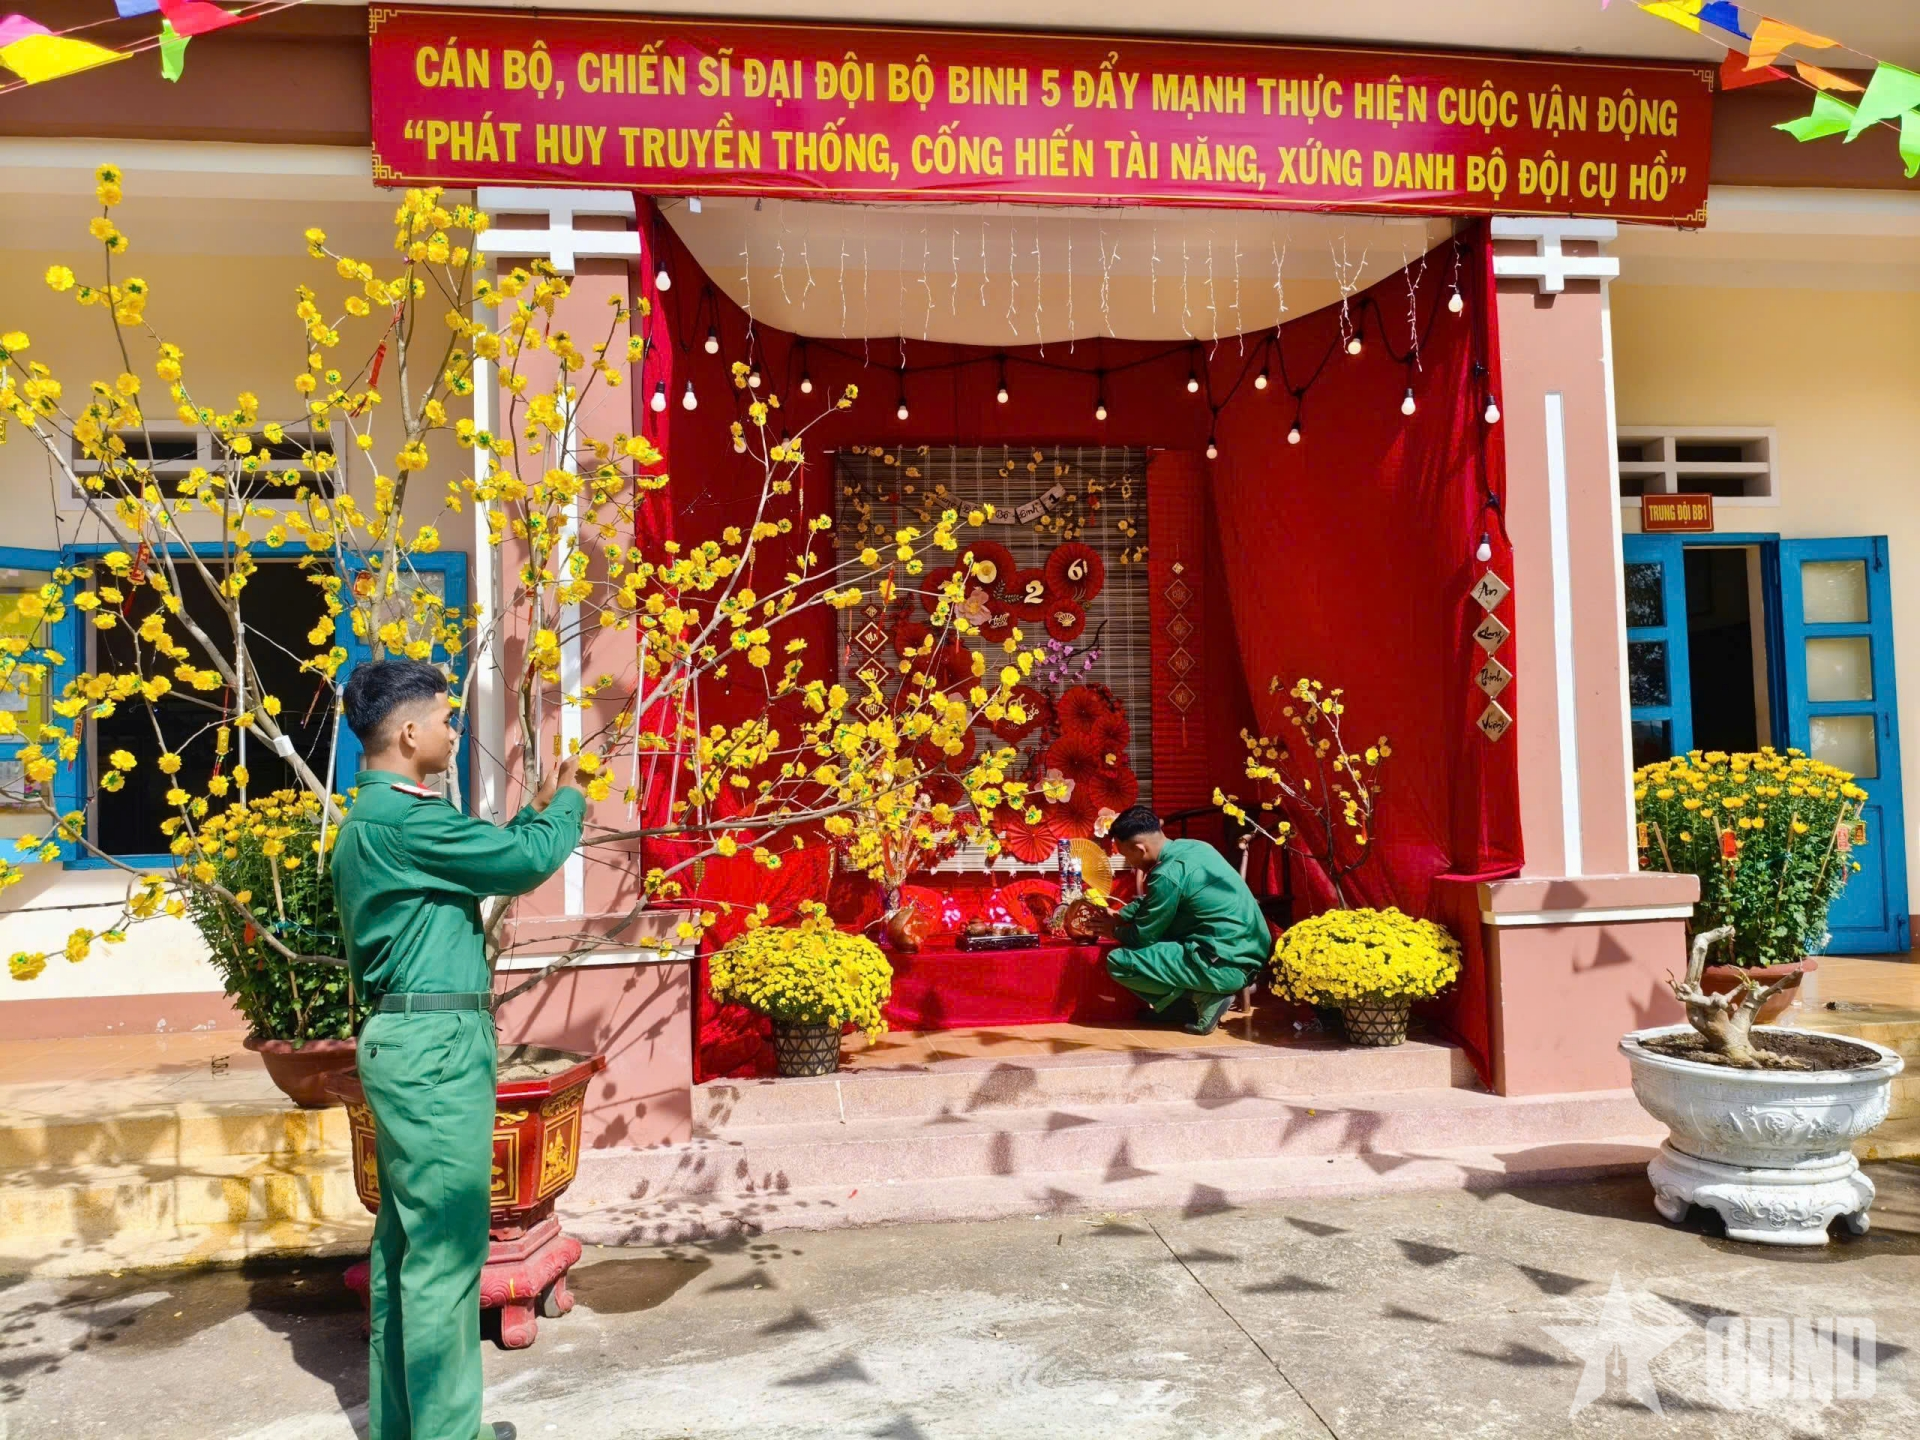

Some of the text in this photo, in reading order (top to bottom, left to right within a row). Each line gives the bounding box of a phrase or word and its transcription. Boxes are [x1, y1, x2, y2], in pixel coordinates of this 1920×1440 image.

[415, 36, 1678, 142] CÁN BỘ, CHIẾN SĨ ĐẠI ĐỘI BỘ BINH 5 ĐẨY MẠNH THỰC HIỆN CUỘC VẬN ĐỘNG
[536, 124, 607, 166] HUY
[618, 112, 761, 170] TRUYỀN
[772, 116, 900, 180] THỐNG,
[911, 119, 1003, 176] CỐNG
[1015, 122, 1094, 179] HIẾN
[1104, 130, 1158, 180] TÀI
[1171, 136, 1267, 191] NĂNG,
[1278, 137, 1363, 188] XỨNG
[1373, 151, 1455, 192] DANH
[1466, 146, 1508, 204] BỘ
[1517, 149, 1569, 204] ĐỘI
[1579, 161, 1617, 207] CỤ
[1649, 501, 1708, 525] TRUNG ĐỘI BB1
[1024, 579, 1044, 604] 2
[1478, 581, 1498, 599] An
